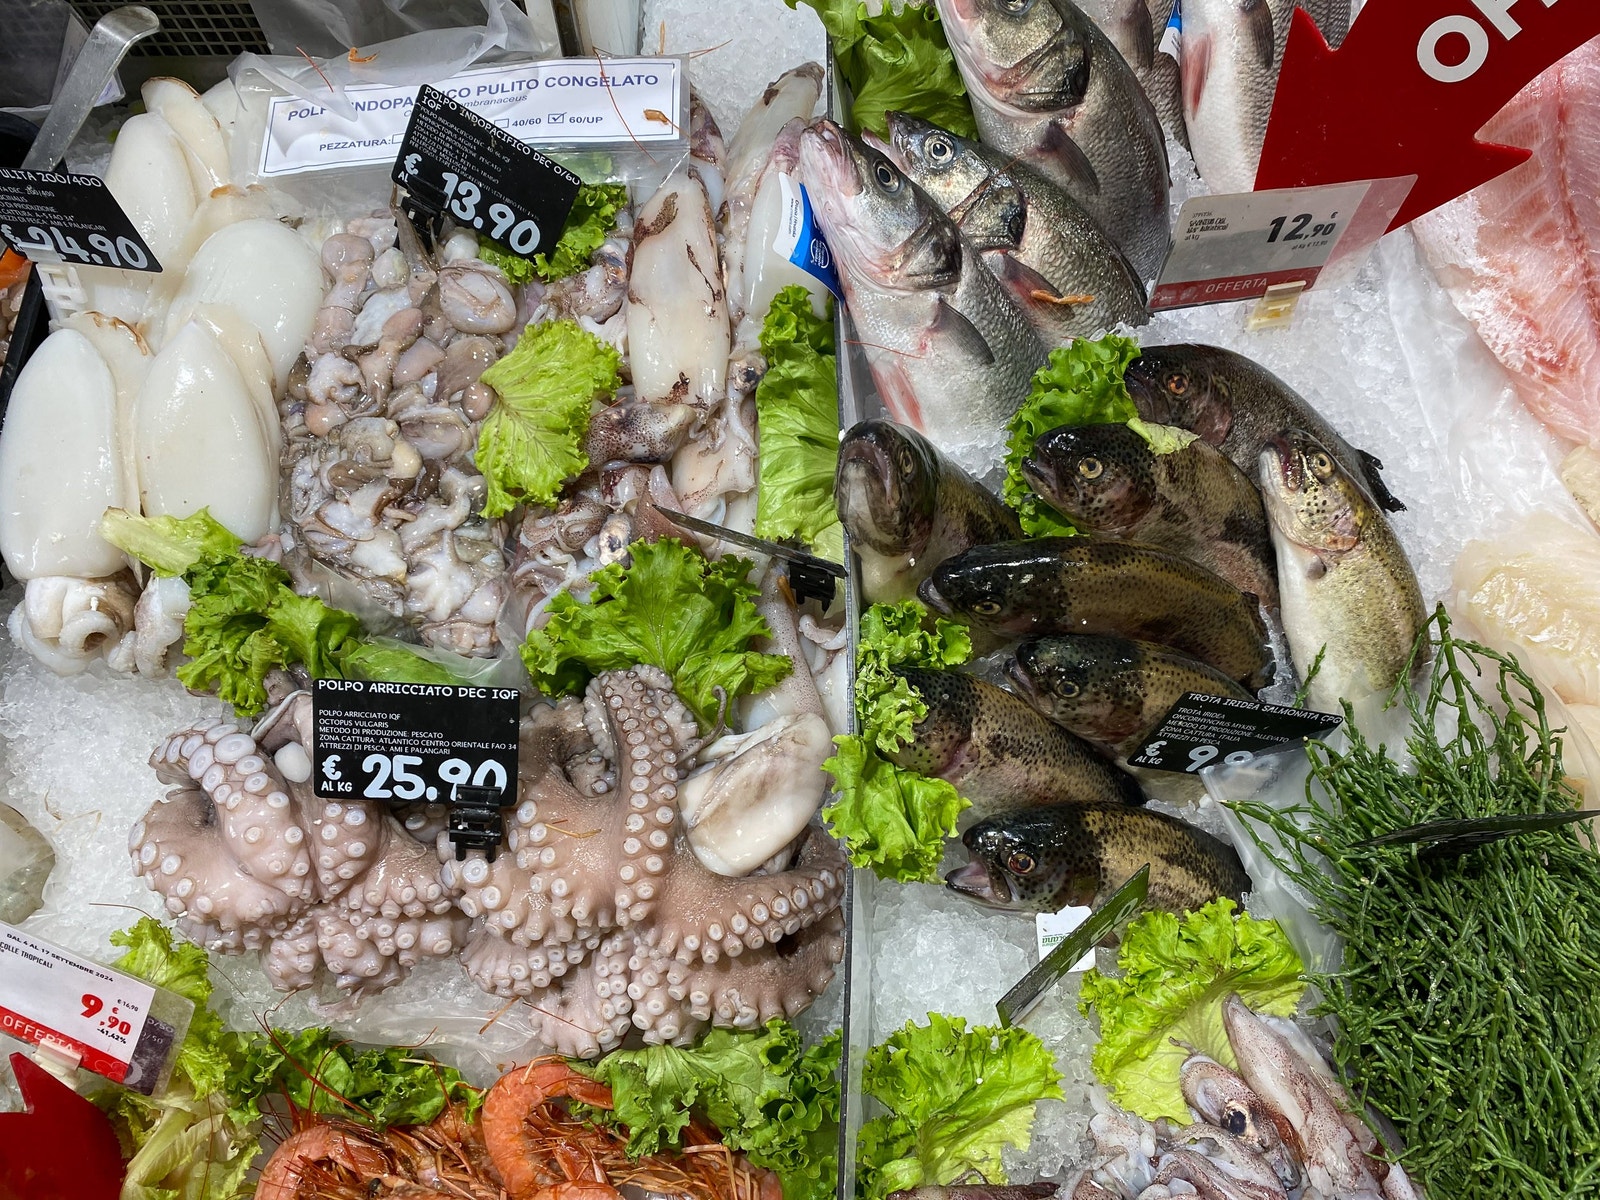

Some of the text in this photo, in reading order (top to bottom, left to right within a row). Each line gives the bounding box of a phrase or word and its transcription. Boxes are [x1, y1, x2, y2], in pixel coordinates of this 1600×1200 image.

[476, 78, 539, 96] PULITO
[545, 75, 658, 89] CONGELATO
[421, 95, 441, 112] IQF
[460, 94, 528, 107] mbranaceus
[420, 105, 437, 119] POLPO
[319, 116, 603, 151] PEZZATURA: 40/60 60/UP
[424, 86, 457, 111] POLPO
[457, 106, 531, 155] INDOPACIFICO
[532, 152, 551, 168] DEC
[404, 153, 422, 176] €
[37, 172, 102, 187] 200/400
[441, 172, 541, 255] 13.90
[1267, 212, 1336, 243] 12,90
[27, 226, 148, 269] 24.90
[1205, 277, 1268, 294] OFFERTA
[318, 679, 518, 701] POLPO ARRICCIATO DEC IQF
[343, 710, 387, 719] ARRICCIATO
[1176, 707, 1226, 719] TROTA IRIDEA
[1188, 693, 1222, 704] TROTA
[1221, 698, 1260, 710] IRIDEA
[1260, 704, 1320, 720] SALMONATA
[319, 718, 388, 728] OCTOPUS VULGARIS
[1170, 713, 1232, 726] ONCORHYNCHUS
[319, 726, 350, 734] METODO
[361, 728, 409, 737] PRODUZIONE:
[1156, 731, 1190, 741] ATTREZZI
[1160, 725, 1183, 733] ZONA
[1165, 720, 1199, 728] METODO
[1252, 733, 1290, 742] ALLEVATO
[319, 741, 352, 750] ATTREZZI
[410, 746, 450, 754] PALANGARI
[379, 737, 418, 745] ATLANTICO
[420, 739, 449, 747] CENTRO
[451, 740, 490, 749] ORIENTALE
[1145, 740, 1167, 757] €
[322, 753, 341, 780] €
[362, 753, 508, 802] 25.90
[321, 781, 352, 792] AL KG
[6, 933, 22, 944] DAL
[51, 953, 95, 974] SETTEMBRE
[95, 971, 114, 982] 2024
[21, 950, 53, 969] TROPICALI
[97, 1028, 127, 1044] -41,42%
